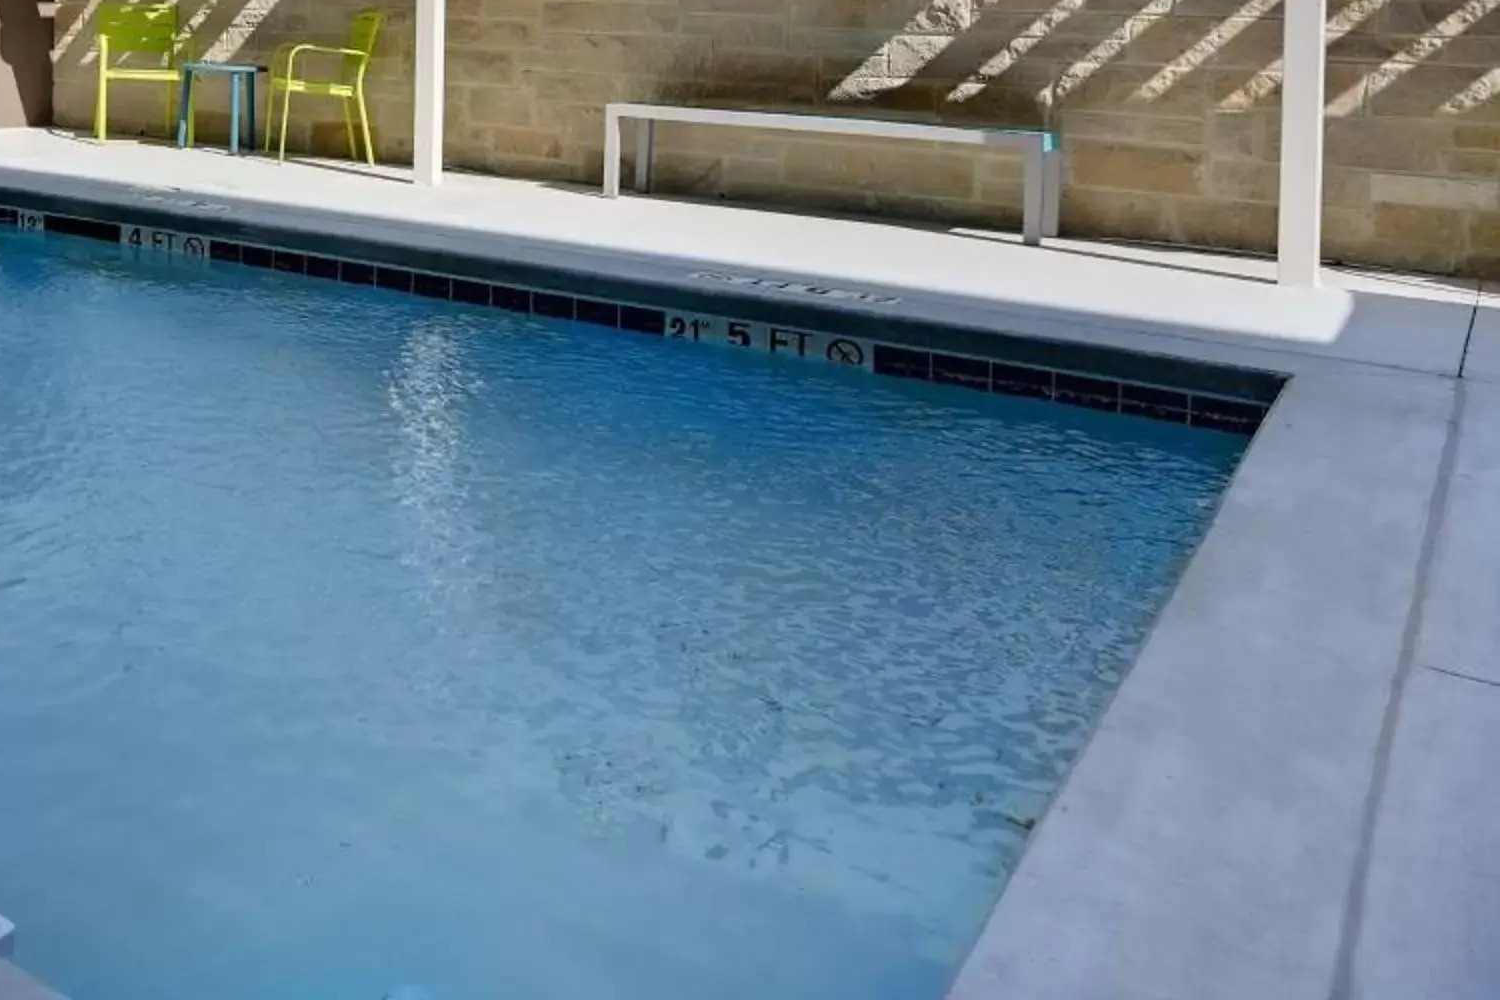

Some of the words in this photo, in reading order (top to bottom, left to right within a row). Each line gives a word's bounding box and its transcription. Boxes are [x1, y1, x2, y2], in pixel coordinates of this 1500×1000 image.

[128, 227, 143, 247] 4
[726, 321, 751, 347] 5
[768, 327, 815, 357] FT
